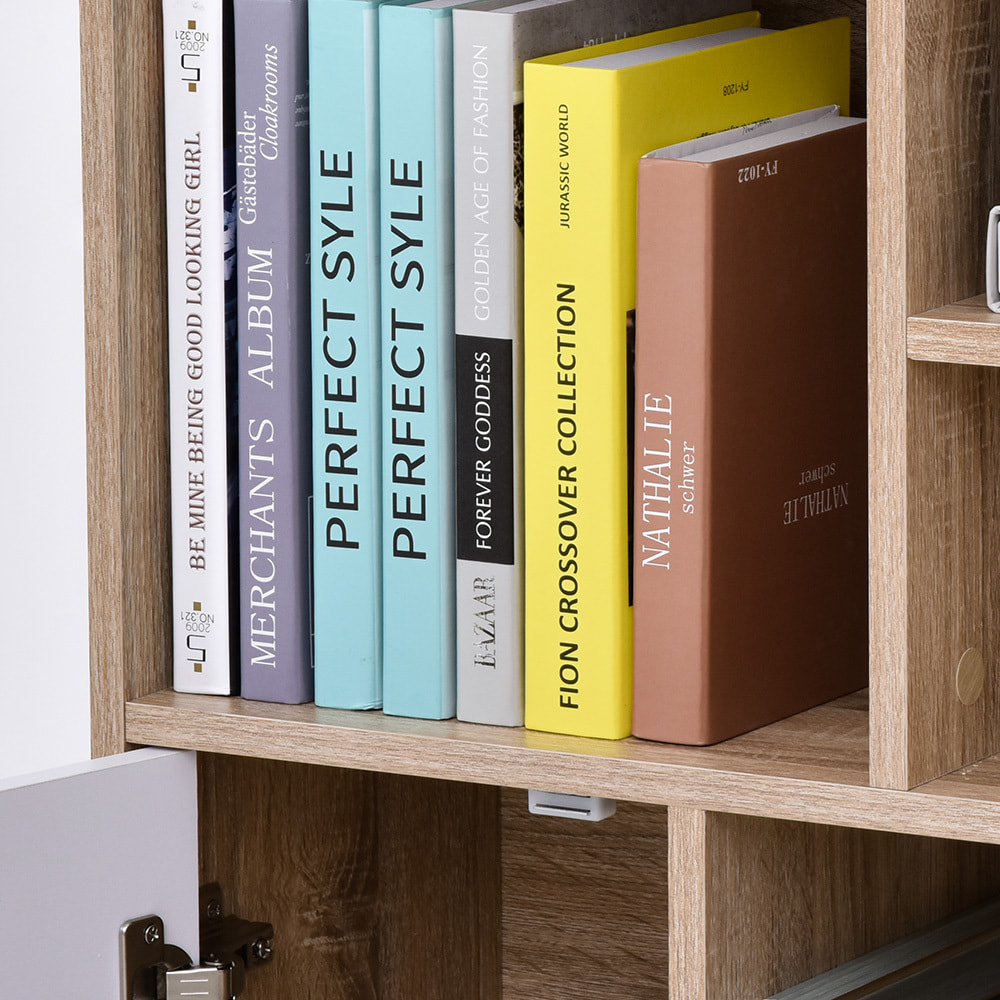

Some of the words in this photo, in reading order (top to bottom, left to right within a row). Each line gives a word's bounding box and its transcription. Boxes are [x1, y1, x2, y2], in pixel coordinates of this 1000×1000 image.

[180, 42, 205, 51] 2009
[259, 43, 278, 160] Cloakrooms
[472, 45, 489, 138] FASHION
[722, 80, 750, 97] FY-1208
[184, 133, 200, 190] GIRL
[237, 111, 257, 225] Gästebäder
[473, 149, 489, 174] OF
[558, 103, 568, 159] WORLD
[737, 160, 778, 183] FY-1022
[320, 149, 355, 282] SYLE
[390, 159, 424, 292] SYLE
[473, 181, 489, 224] AGE
[559, 162, 570, 229] JURASSIC
[185, 199, 202, 305] LOOKING
[474, 231, 490, 321] GOLDEN
[186, 313, 204, 381] GOOD
[248, 247, 273, 389] ALBUM
[474, 351, 490, 452] GODDESS
[556, 283, 577, 456] COLLECTION
[187, 388, 204, 463] BEING
[322, 299, 360, 549] PERFECT
[391, 308, 427, 560] PERFECT
[188, 471, 205, 531] MINE
[475, 460, 492, 550] FOREVER
[642, 393, 672, 570] NATHALIE
[678, 441, 695, 514] schwer
[783, 482, 849, 525] NATHALIE
[799, 462, 836, 485] schwer
[190, 537, 206, 571] BE
[248, 418, 276, 668] MERCHANTS
[558, 465, 578, 633] CROSSOVER
[186, 622, 211, 633] 2009
[472, 575, 496, 669] BAZAAR
[559, 641, 579, 709] FION
